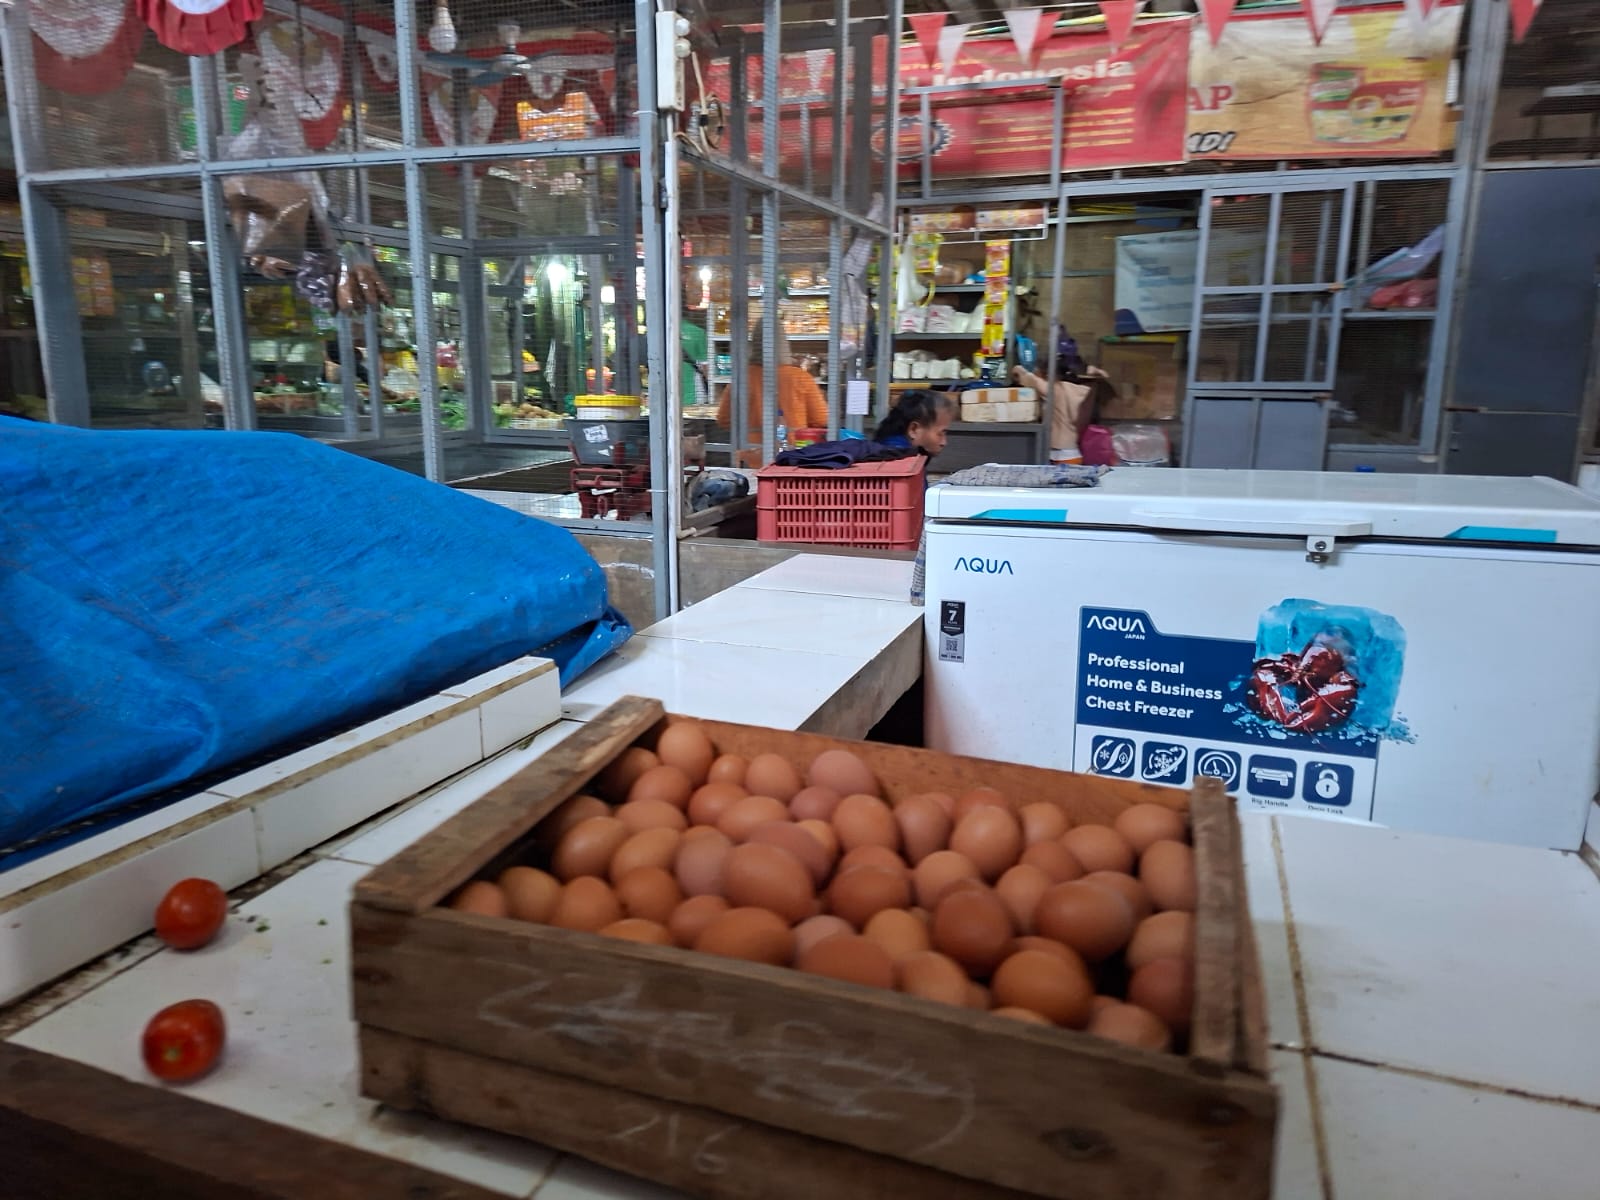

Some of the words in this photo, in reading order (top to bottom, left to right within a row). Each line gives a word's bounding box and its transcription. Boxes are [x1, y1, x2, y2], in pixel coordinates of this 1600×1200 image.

[954, 556, 1014, 576] AQUA
[948, 610, 957, 622] 7
[1086, 615, 1146, 634] AQUA
[1124, 633, 1146, 641] JAPAN
[1087, 652, 1185, 674] Professional
[1086, 674, 1133, 691] Home
[1135, 679, 1148, 693] &
[1150, 680, 1223, 700] Business
[1085, 695, 1132, 713] Chest
[1134, 700, 1194, 719] Freezer
